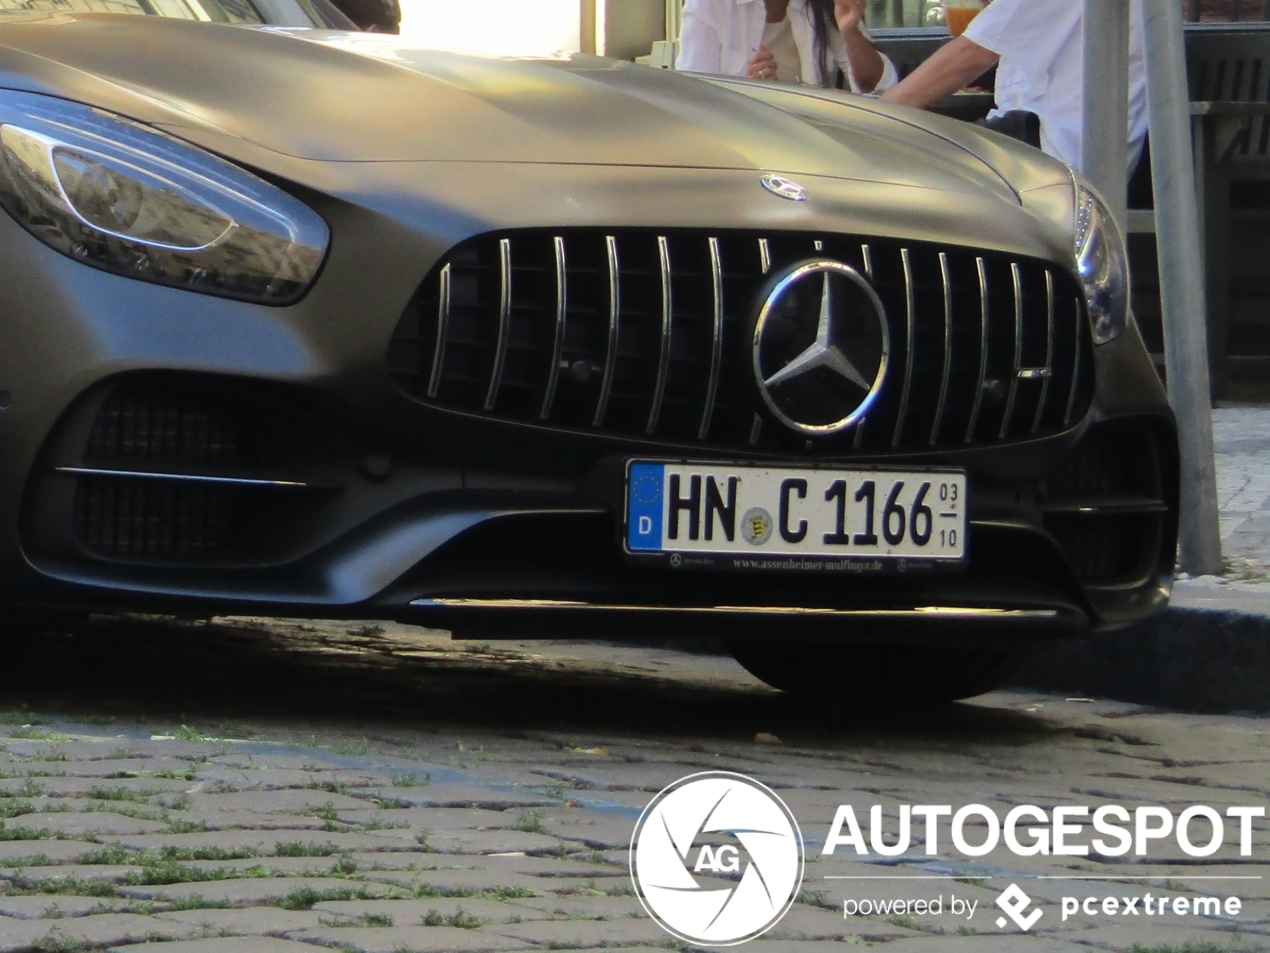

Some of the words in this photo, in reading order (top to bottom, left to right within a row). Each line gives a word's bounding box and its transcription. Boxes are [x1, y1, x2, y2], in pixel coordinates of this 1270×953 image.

[939, 482, 958, 501] 03
[667, 473, 739, 542] HN
[779, 477, 808, 544] C
[823, 479, 932, 546] 1166
[638, 516, 652, 535] D
[939, 528, 958, 547] 10
